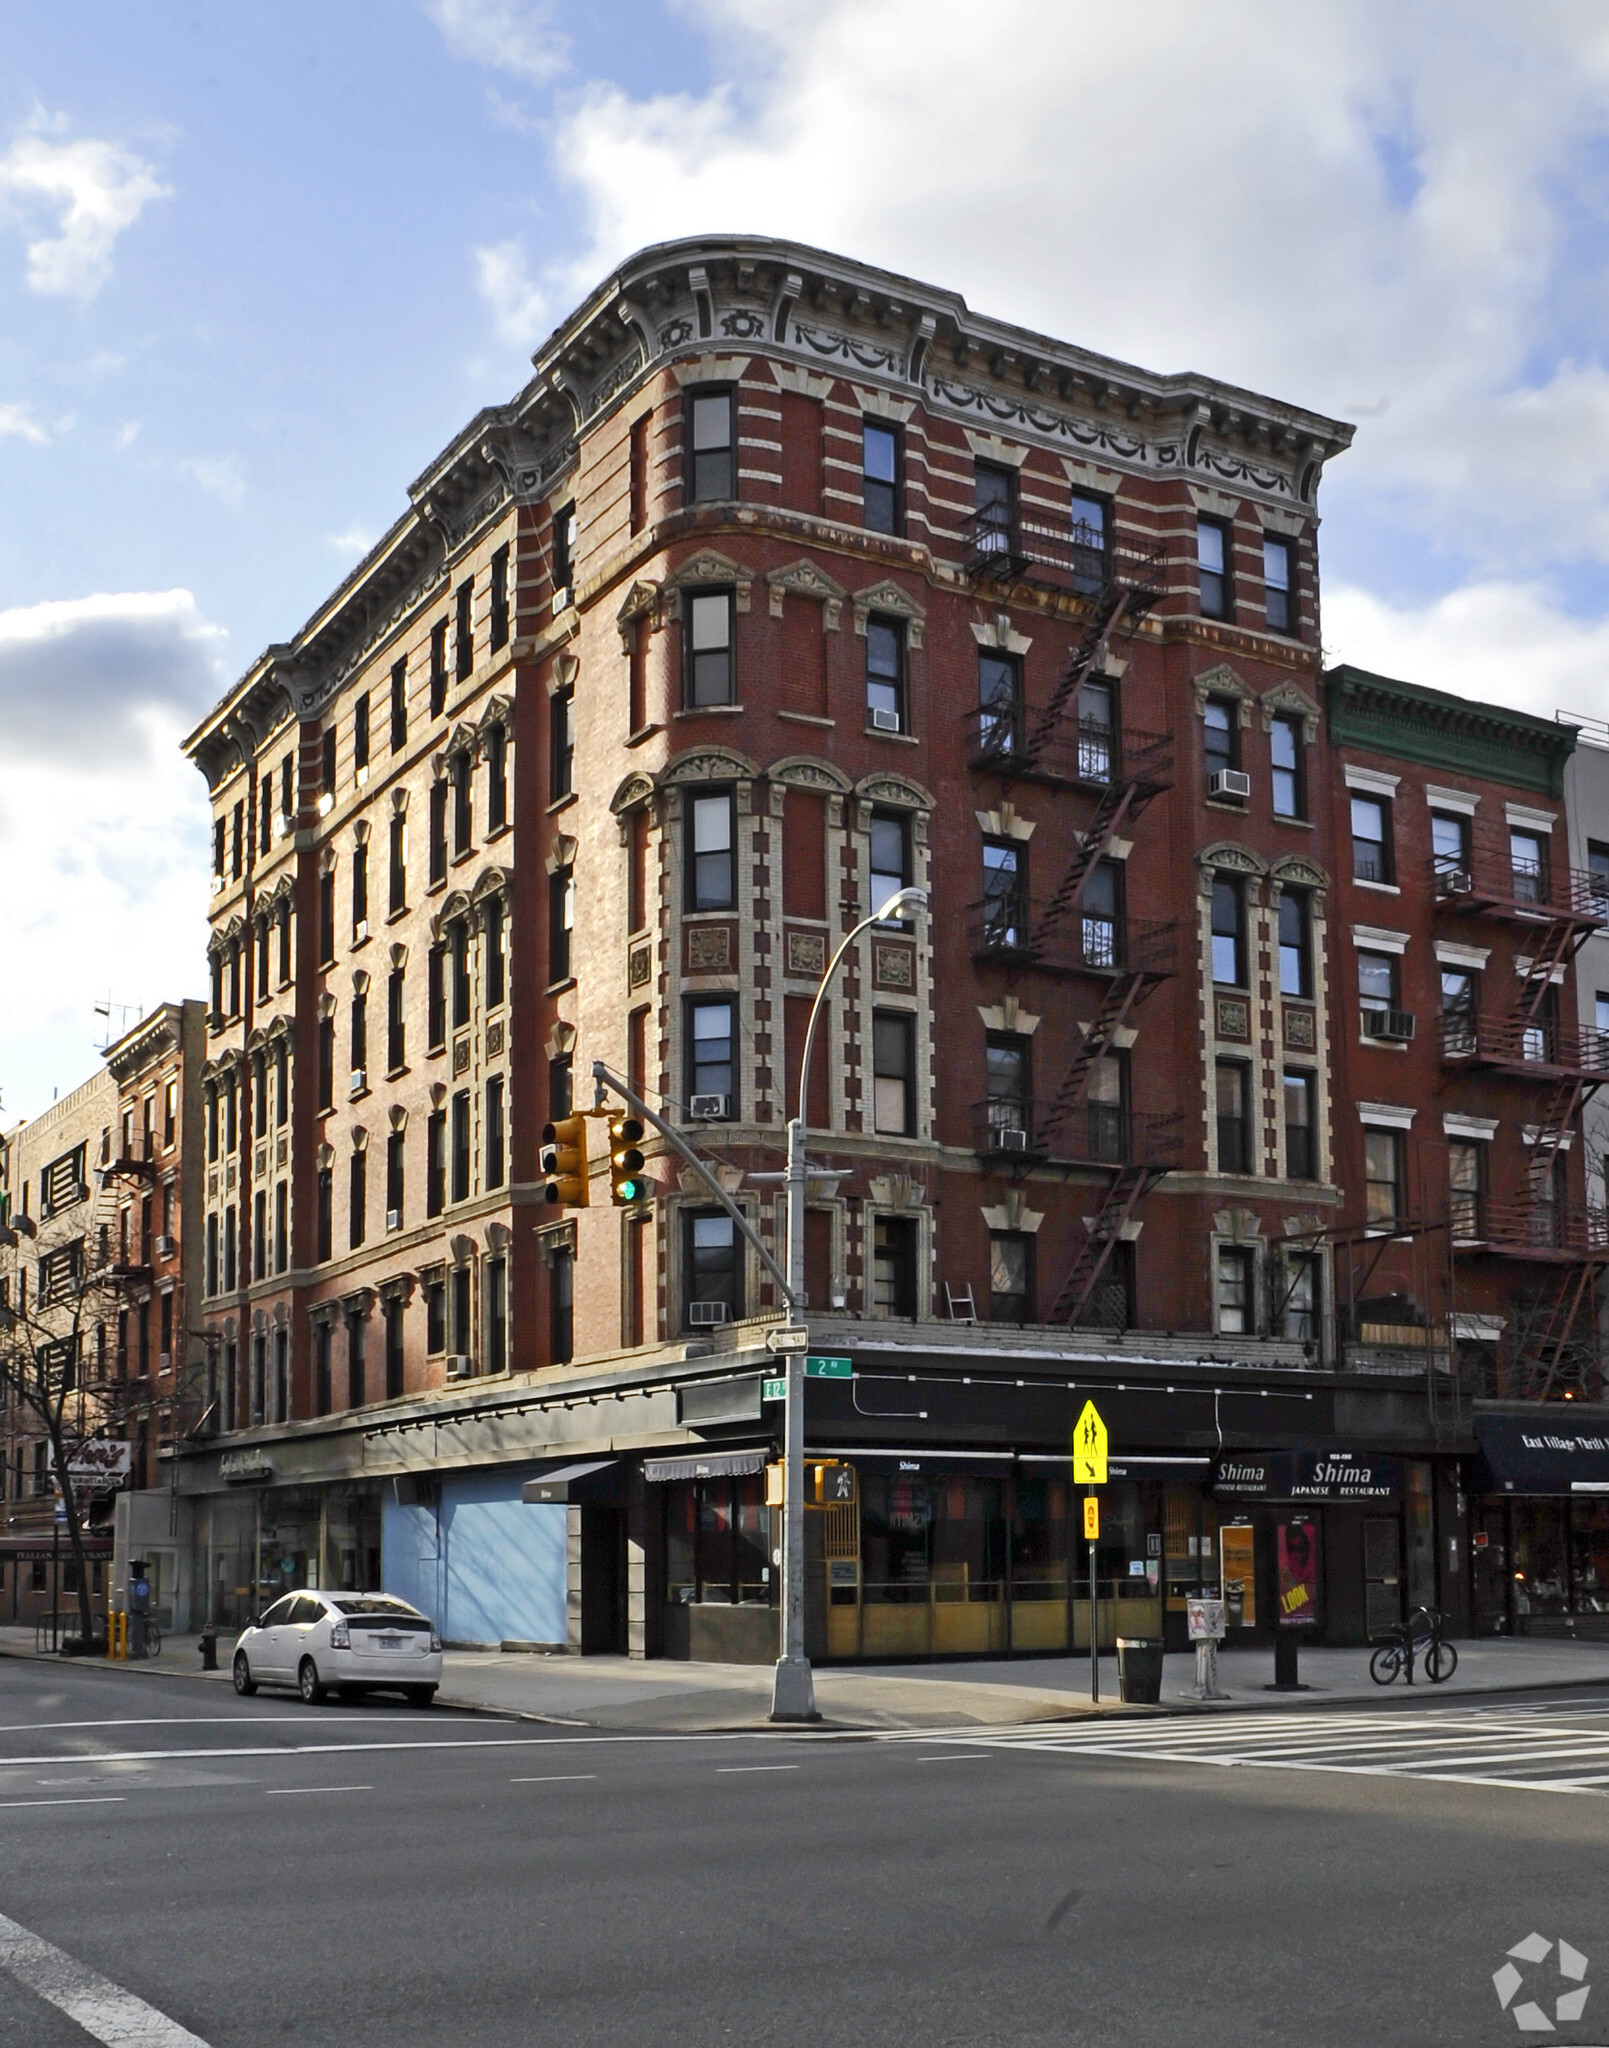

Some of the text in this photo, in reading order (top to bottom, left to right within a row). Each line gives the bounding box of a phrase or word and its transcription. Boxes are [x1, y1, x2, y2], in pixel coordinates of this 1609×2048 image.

[772, 1335, 784, 1347] ONE
[818, 1360, 826, 1375] 2
[766, 1383, 772, 1398] E
[773, 1382, 781, 1397] 12
[1521, 1434, 1545, 1448] East
[1543, 1435, 1576, 1452] Village
[1575, 1436, 1606, 1450] Thrift
[899, 1461, 920, 1471] Shima
[1109, 1466, 1127, 1476] Shima
[1218, 1463, 1265, 1480] Shima
[1313, 1462, 1371, 1483] Shima
[1291, 1486, 1391, 1496] JAPANESE RESTAURANT
[58, 1551, 112, 1560] RESTURANT
[1281, 1583, 1309, 1614] LOOK
